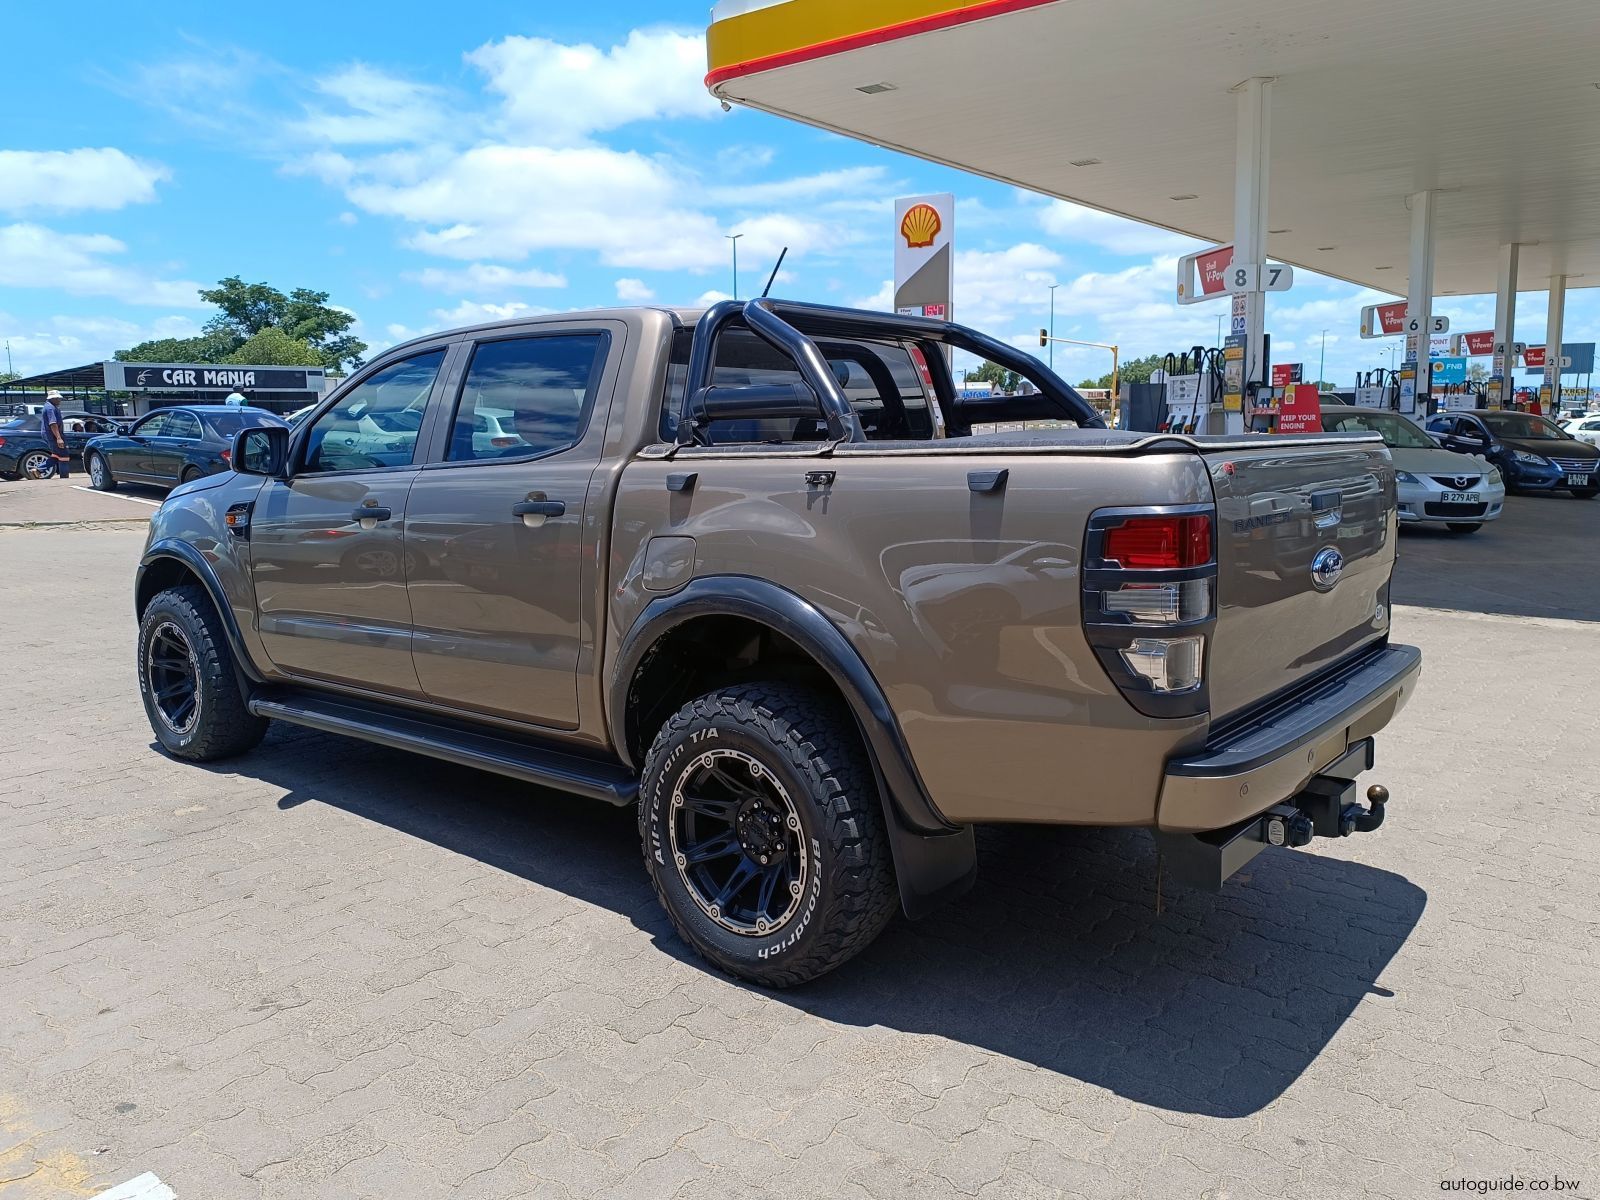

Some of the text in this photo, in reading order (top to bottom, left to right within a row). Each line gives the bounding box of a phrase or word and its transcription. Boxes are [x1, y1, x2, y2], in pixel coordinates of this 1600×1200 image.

[1206, 261, 1217, 271] Shell
[1235, 269, 1248, 287] 8
[1269, 269, 1282, 286] 7
[1409, 319, 1419, 331] 6
[1434, 319, 1443, 331] 5
[1497, 345, 1505, 354] 4
[1514, 344, 1521, 354] 3
[1548, 358, 1555, 366] 2
[1562, 358, 1567, 366] 1
[162, 369, 256, 386] CAR MANIA
[1280, 414, 1297, 422] KEEP
[1280, 422, 1306, 430] ENGINE
[1443, 493, 1450, 501] B
[1451, 493, 1465, 502] 279
[650, 727, 720, 867] All-Terrain T/A
[758, 837, 822, 961] BFGoodrich
